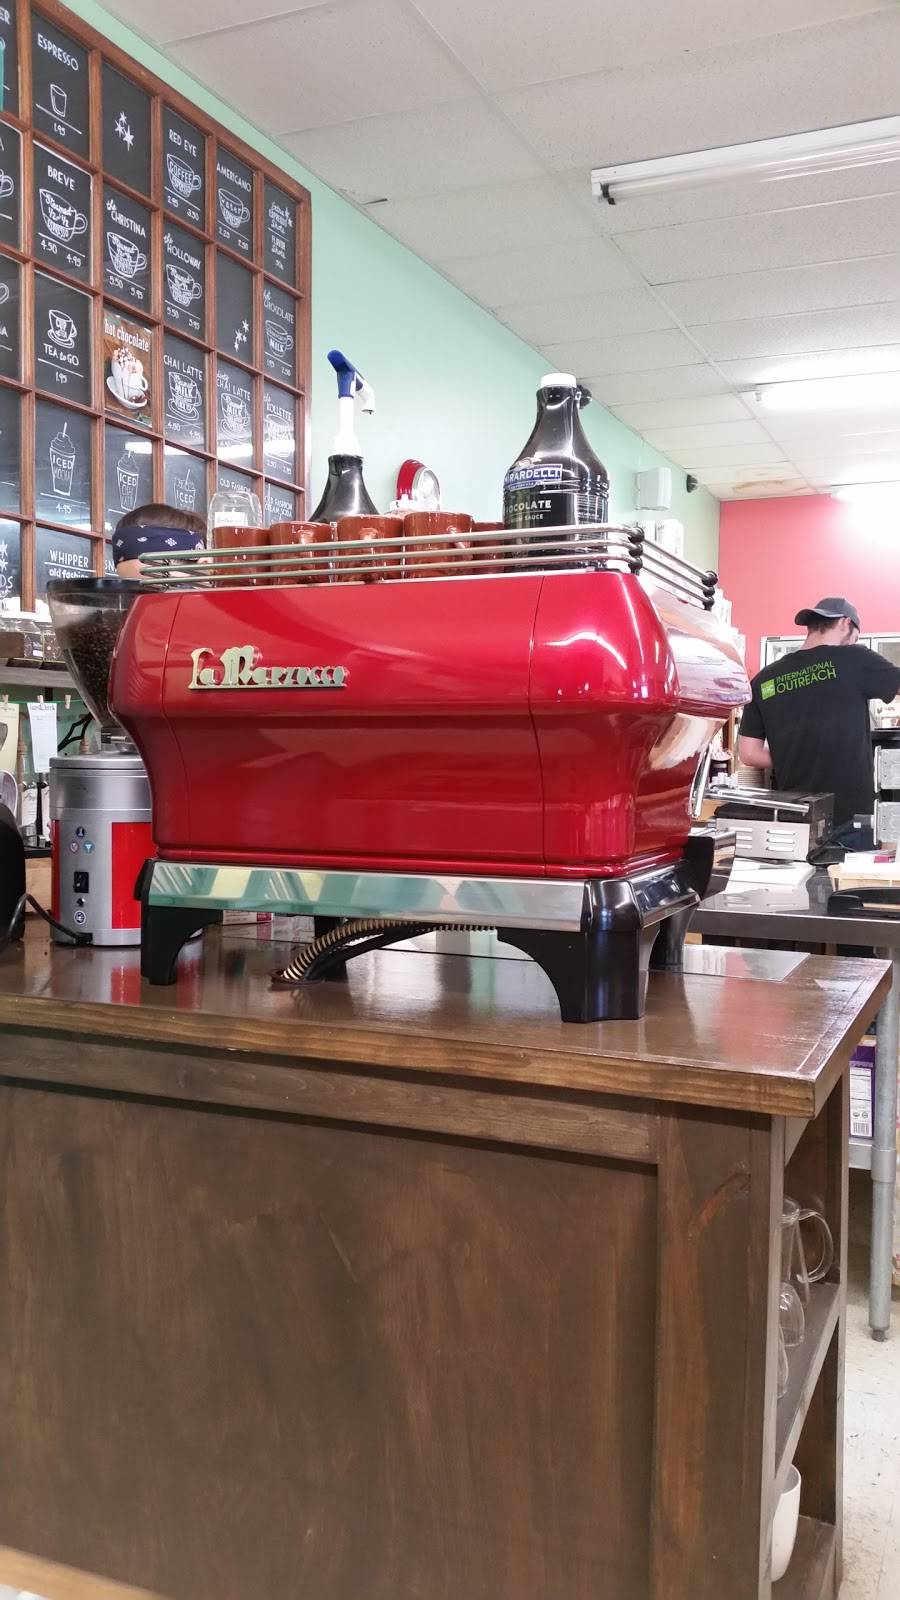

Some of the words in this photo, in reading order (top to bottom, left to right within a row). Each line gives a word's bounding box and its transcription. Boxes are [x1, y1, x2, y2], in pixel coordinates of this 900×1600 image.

[37, 33, 79, 71] ESPRESSO
[169, 129, 182, 146] RED
[184, 140, 197, 157] EYE
[47, 164, 76, 191] BREVE
[169, 160, 192, 185] COFFEE
[216, 162, 252, 193] AMERICANO
[111, 210, 147, 238] CHRISTINA
[40, 239, 58, 254] 4.50
[66, 253, 82, 267] 4.95
[166, 243, 201, 270] HOLLOWAY
[263, 299, 295, 324] CHOCOLATE
[104, 318, 116, 337] hot
[116, 327, 150, 353] chocolate
[269, 338, 284, 353] MILK
[43, 343, 58, 359] TEA
[60, 351, 67, 361] to
[67, 353, 80, 366] GO
[163, 354, 180, 371] CHAI
[182, 362, 203, 381] LATTE
[175, 383, 193, 398] MILK
[216, 378, 231, 393] CHAI
[232, 384, 251, 401] LATTE
[52, 454, 73, 470] ICED
[119, 472, 137, 487] ICED
[220, 478, 231, 488] OLD
[176, 489, 194, 504] ICED
[49, 549, 89, 568] WHIPPER
[48, 567, 61, 577] old
[220, 645, 347, 688] Marzocco
[776, 660, 835, 684] INTERNATIONAL
[776, 668, 837, 694] OUTREACH
